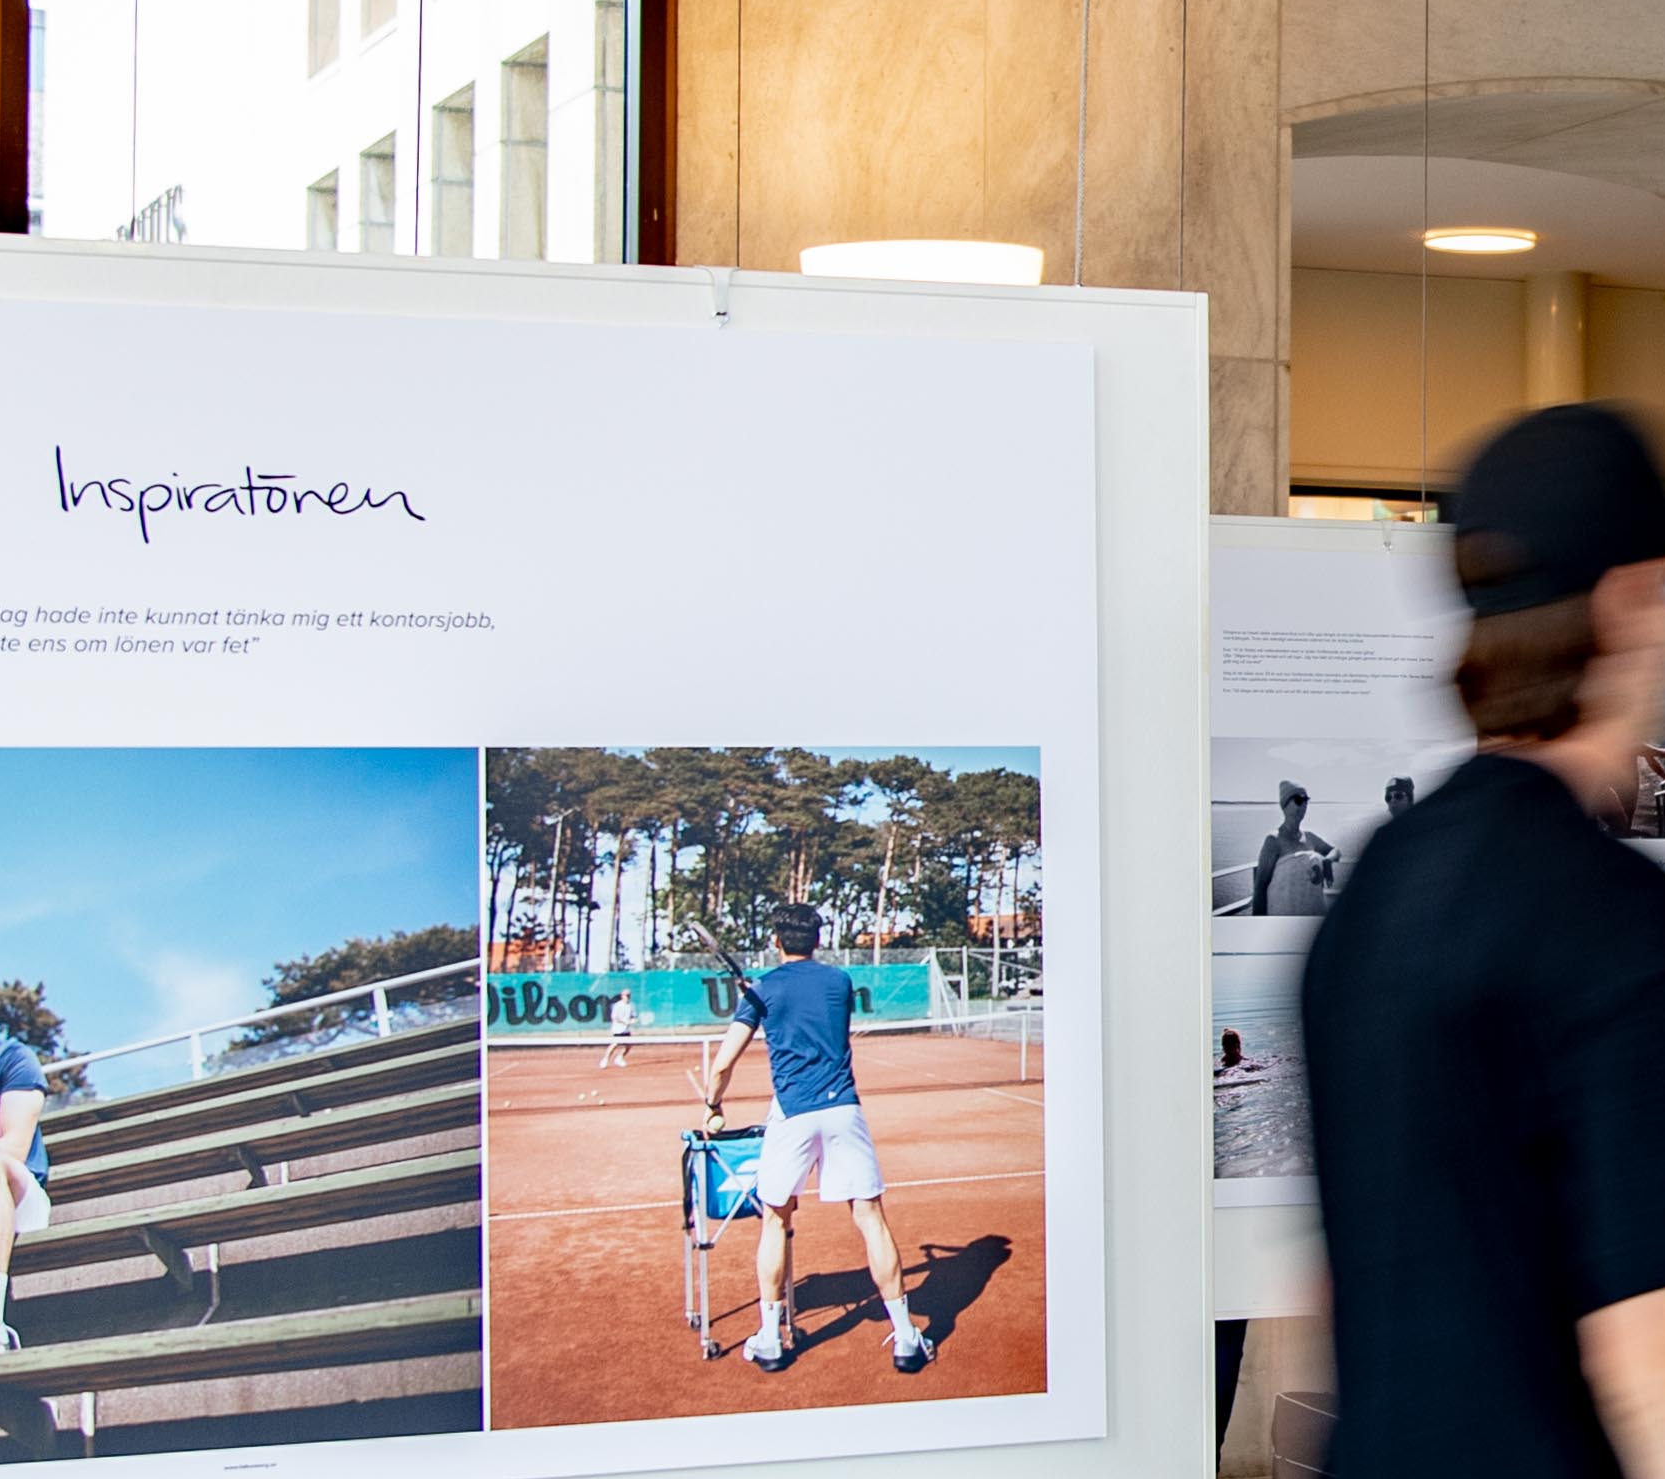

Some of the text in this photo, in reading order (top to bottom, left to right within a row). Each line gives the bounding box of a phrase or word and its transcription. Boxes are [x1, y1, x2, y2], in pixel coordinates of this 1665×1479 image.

[35, 606, 91, 624] hade
[98, 607, 138, 625] inte
[145, 608, 219, 626] kunnat
[226, 609, 285, 627] tänka
[291, 610, 330, 631] mig
[336, 611, 363, 628] ett
[369, 611, 496, 633] kontorsjobb,
[28, 638, 67, 653] ens
[74, 638, 108, 653] om
[115, 635, 175, 653] lönen
[182, 639, 217, 654] var
[487, 980, 623, 1026] ilson
